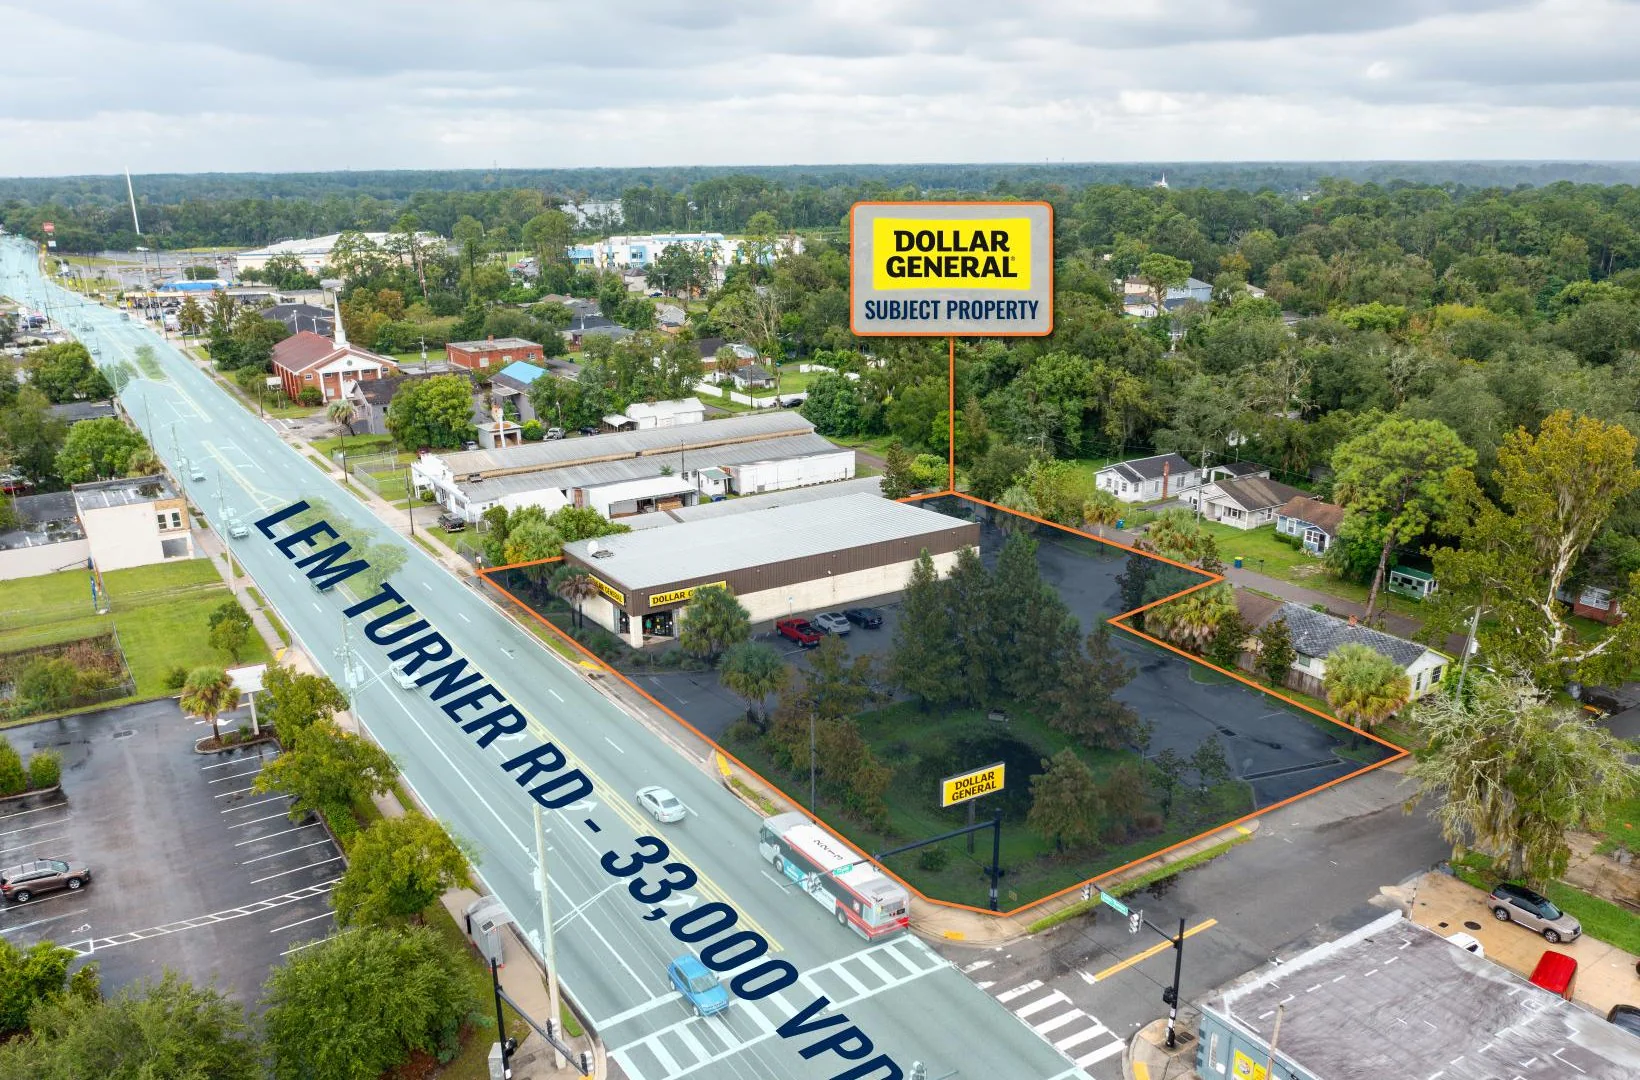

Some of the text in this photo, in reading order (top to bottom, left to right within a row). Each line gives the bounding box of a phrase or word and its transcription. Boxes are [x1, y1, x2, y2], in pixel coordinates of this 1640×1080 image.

[652, 591, 685, 605] DOLLAR
[955, 771, 995, 790] DOLLAR
[951, 781, 997, 801] GENERAL
